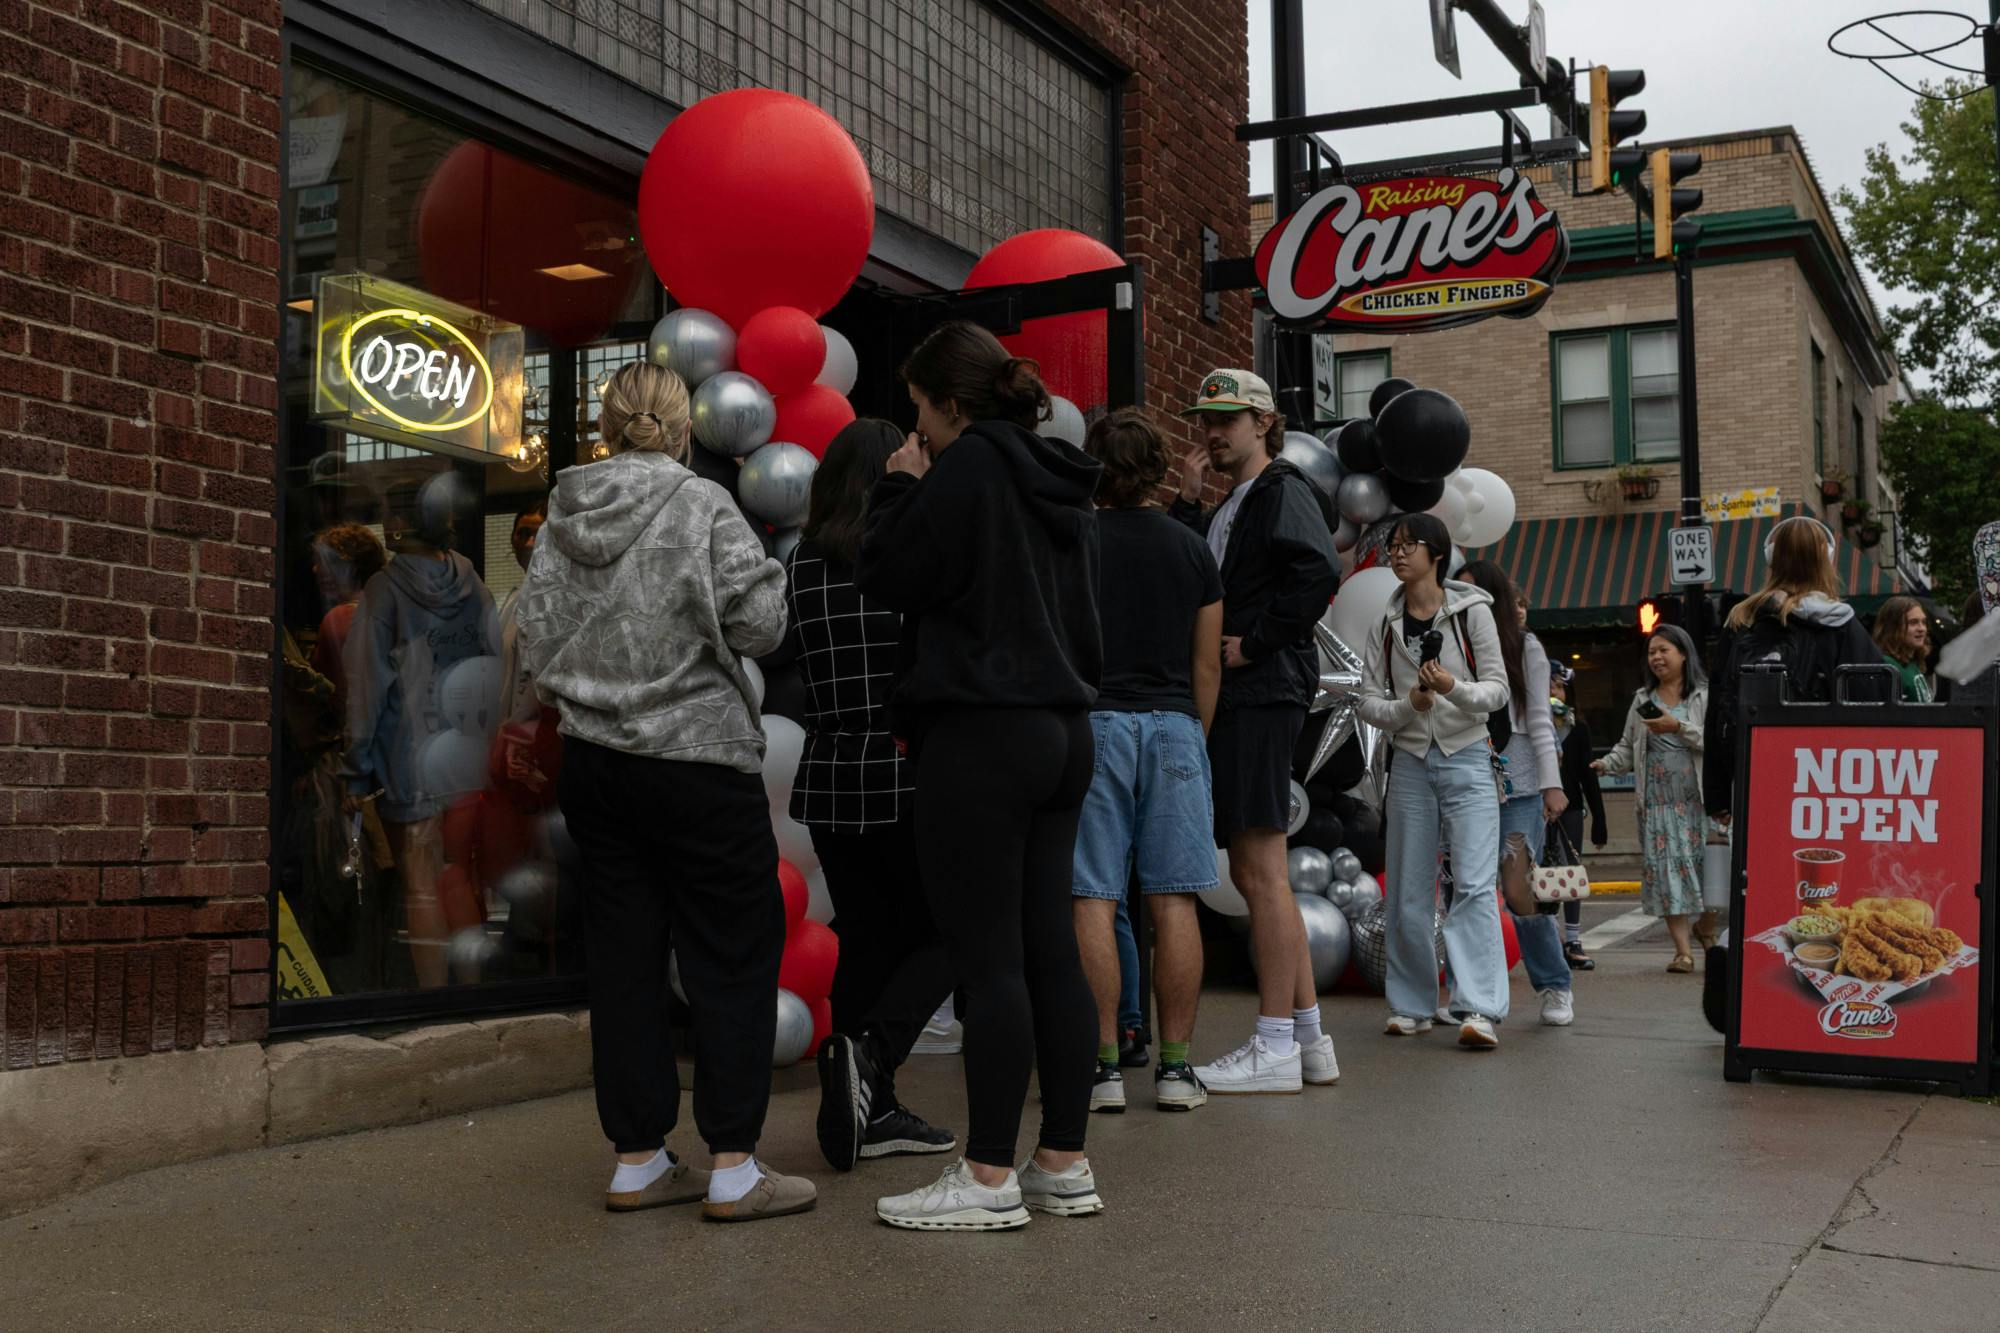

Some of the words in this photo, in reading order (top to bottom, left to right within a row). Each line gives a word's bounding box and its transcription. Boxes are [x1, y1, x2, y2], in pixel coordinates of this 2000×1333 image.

[1367, 181, 1465, 213] Raising
[1267, 167, 1555, 319] Cane's
[1362, 290, 1440, 312] CHICKEN
[1446, 281, 1528, 305] FINGERS
[361, 335, 476, 409] OPEN
[1704, 502, 1719, 512] Jon
[1721, 498, 1762, 512] Sparhawk
[1675, 532, 1706, 546] ONE
[1675, 547, 1708, 560] WAY
[1793, 748, 1939, 796] NOW
[1791, 797, 1939, 843] OPEN
[1823, 1000, 1895, 1034] Cane's
